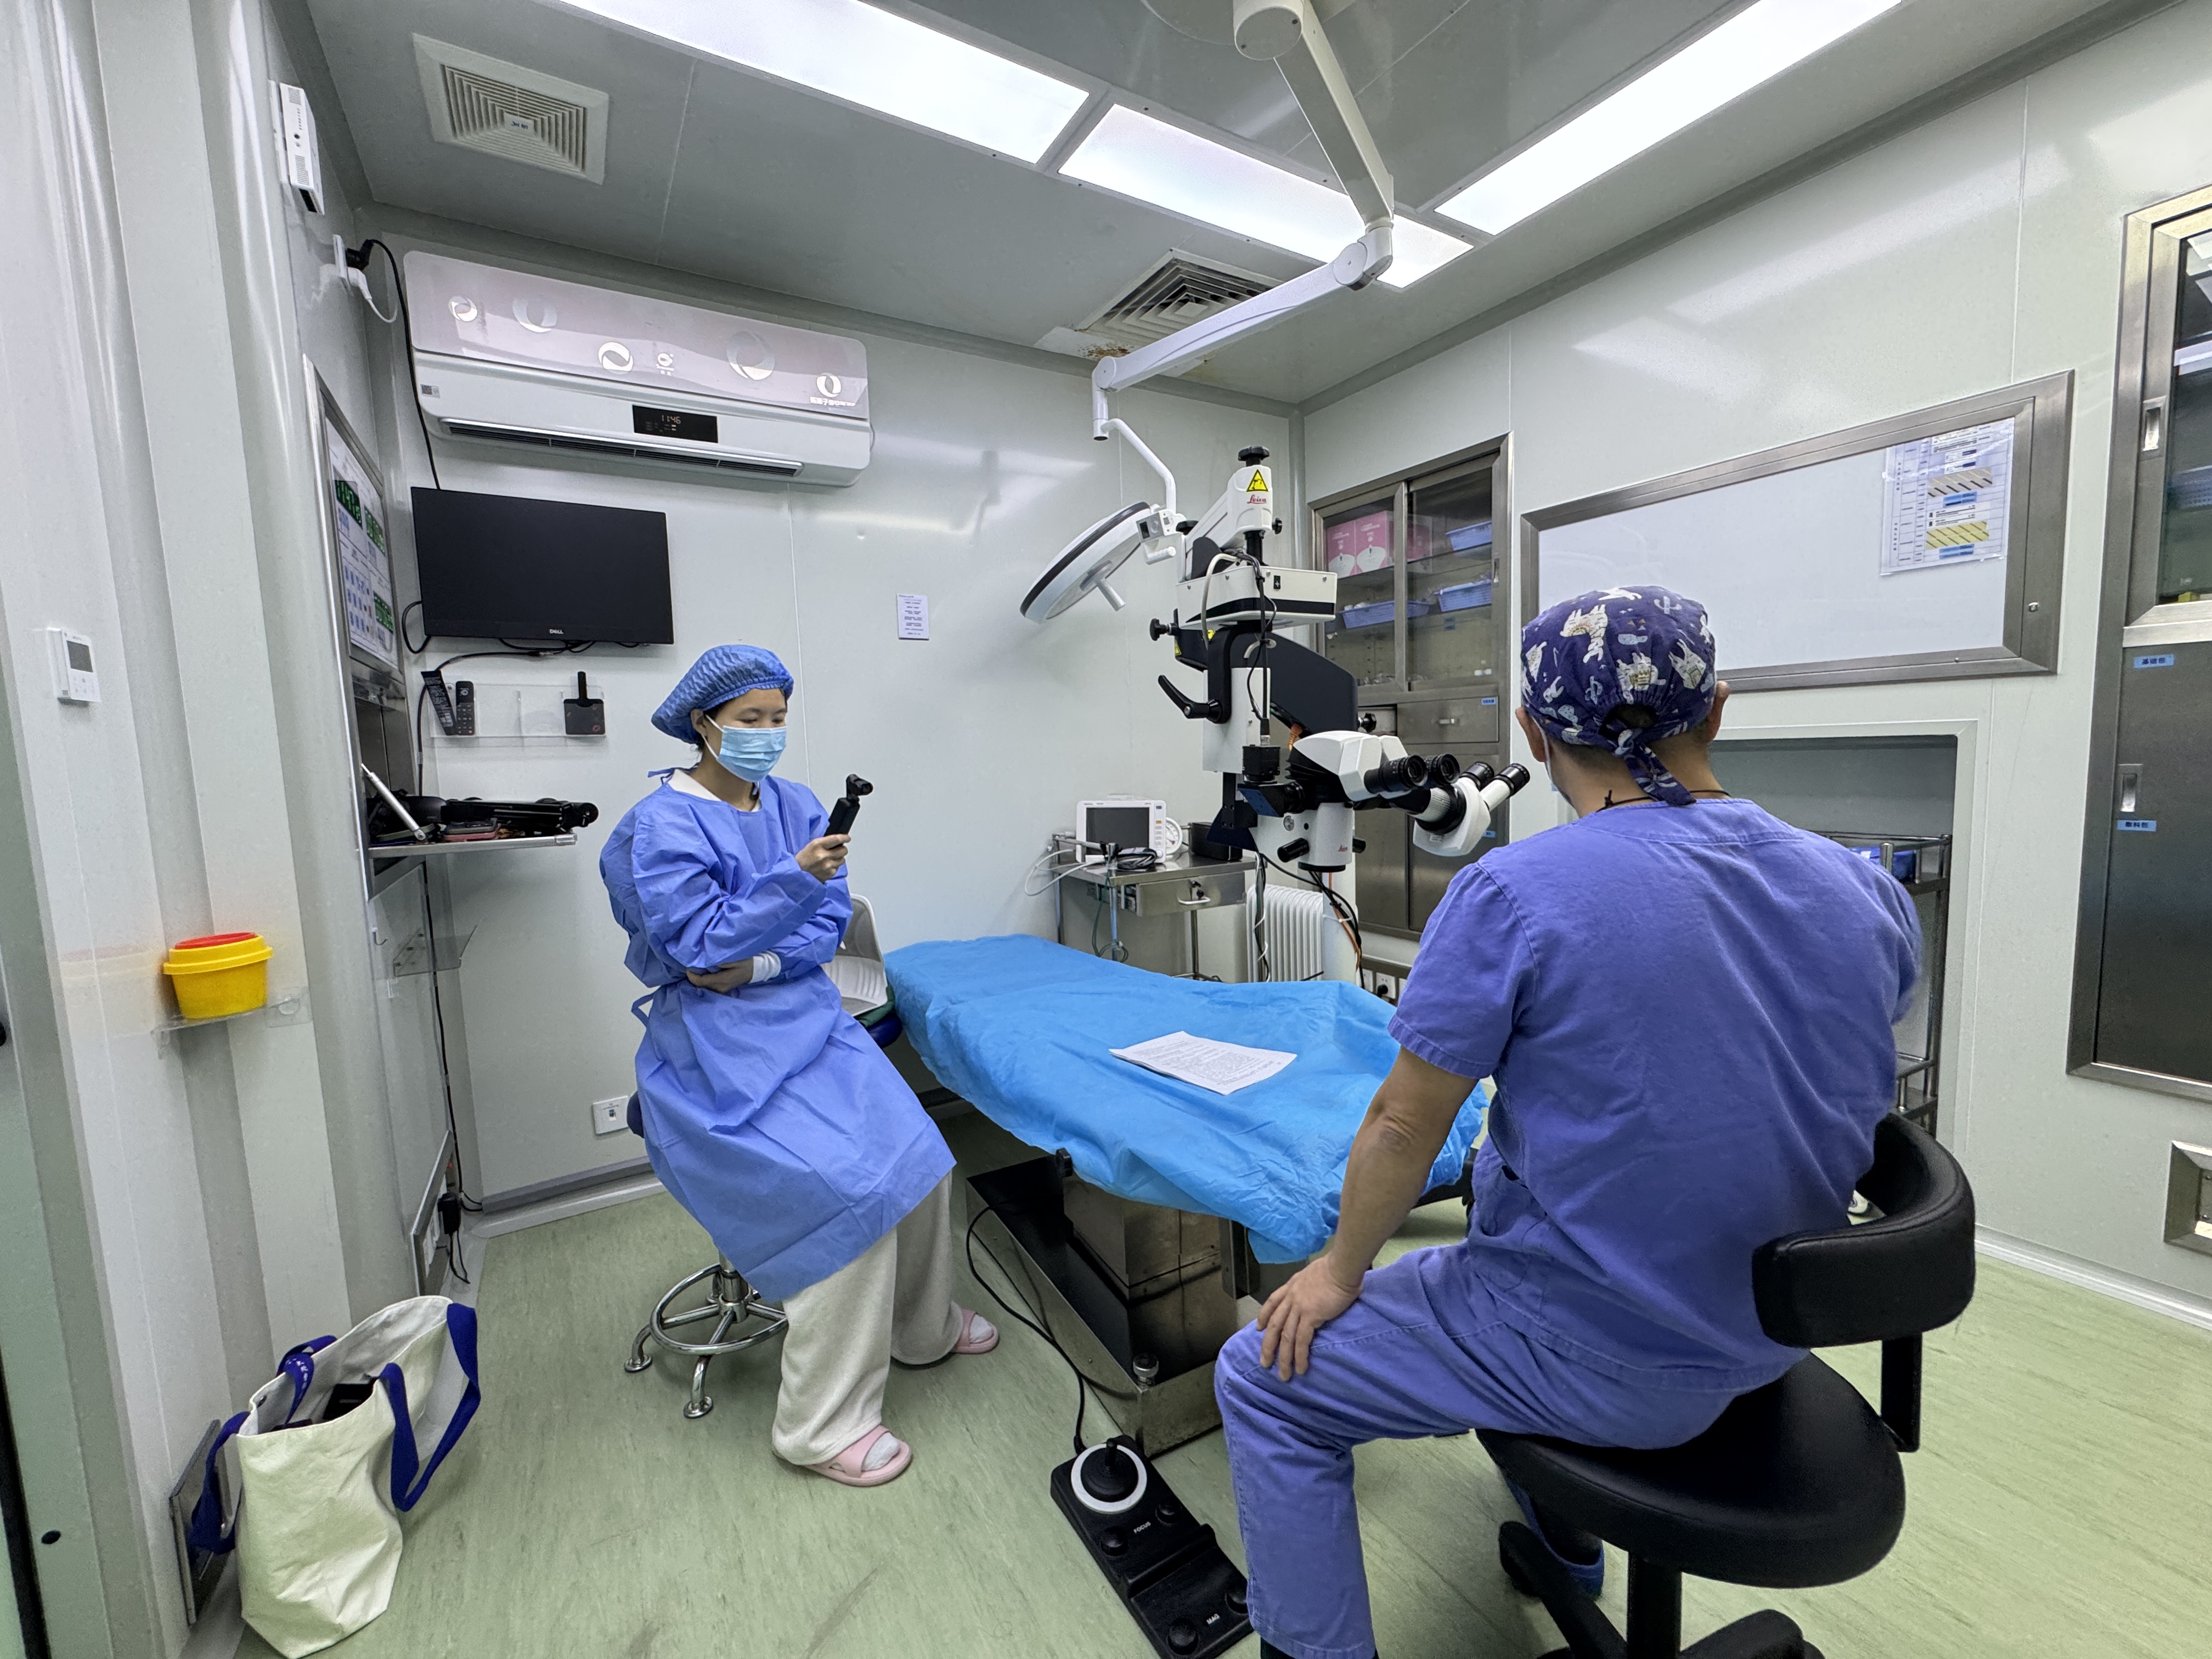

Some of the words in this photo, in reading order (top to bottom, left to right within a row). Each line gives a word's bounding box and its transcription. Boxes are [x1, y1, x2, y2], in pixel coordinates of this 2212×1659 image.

[662, 415, 681, 424] 11:46
[1246, 494, 1267, 504] Leica
[1133, 1521, 1151, 1534] FOCUS
[1206, 1613, 1220, 1624] MAG
